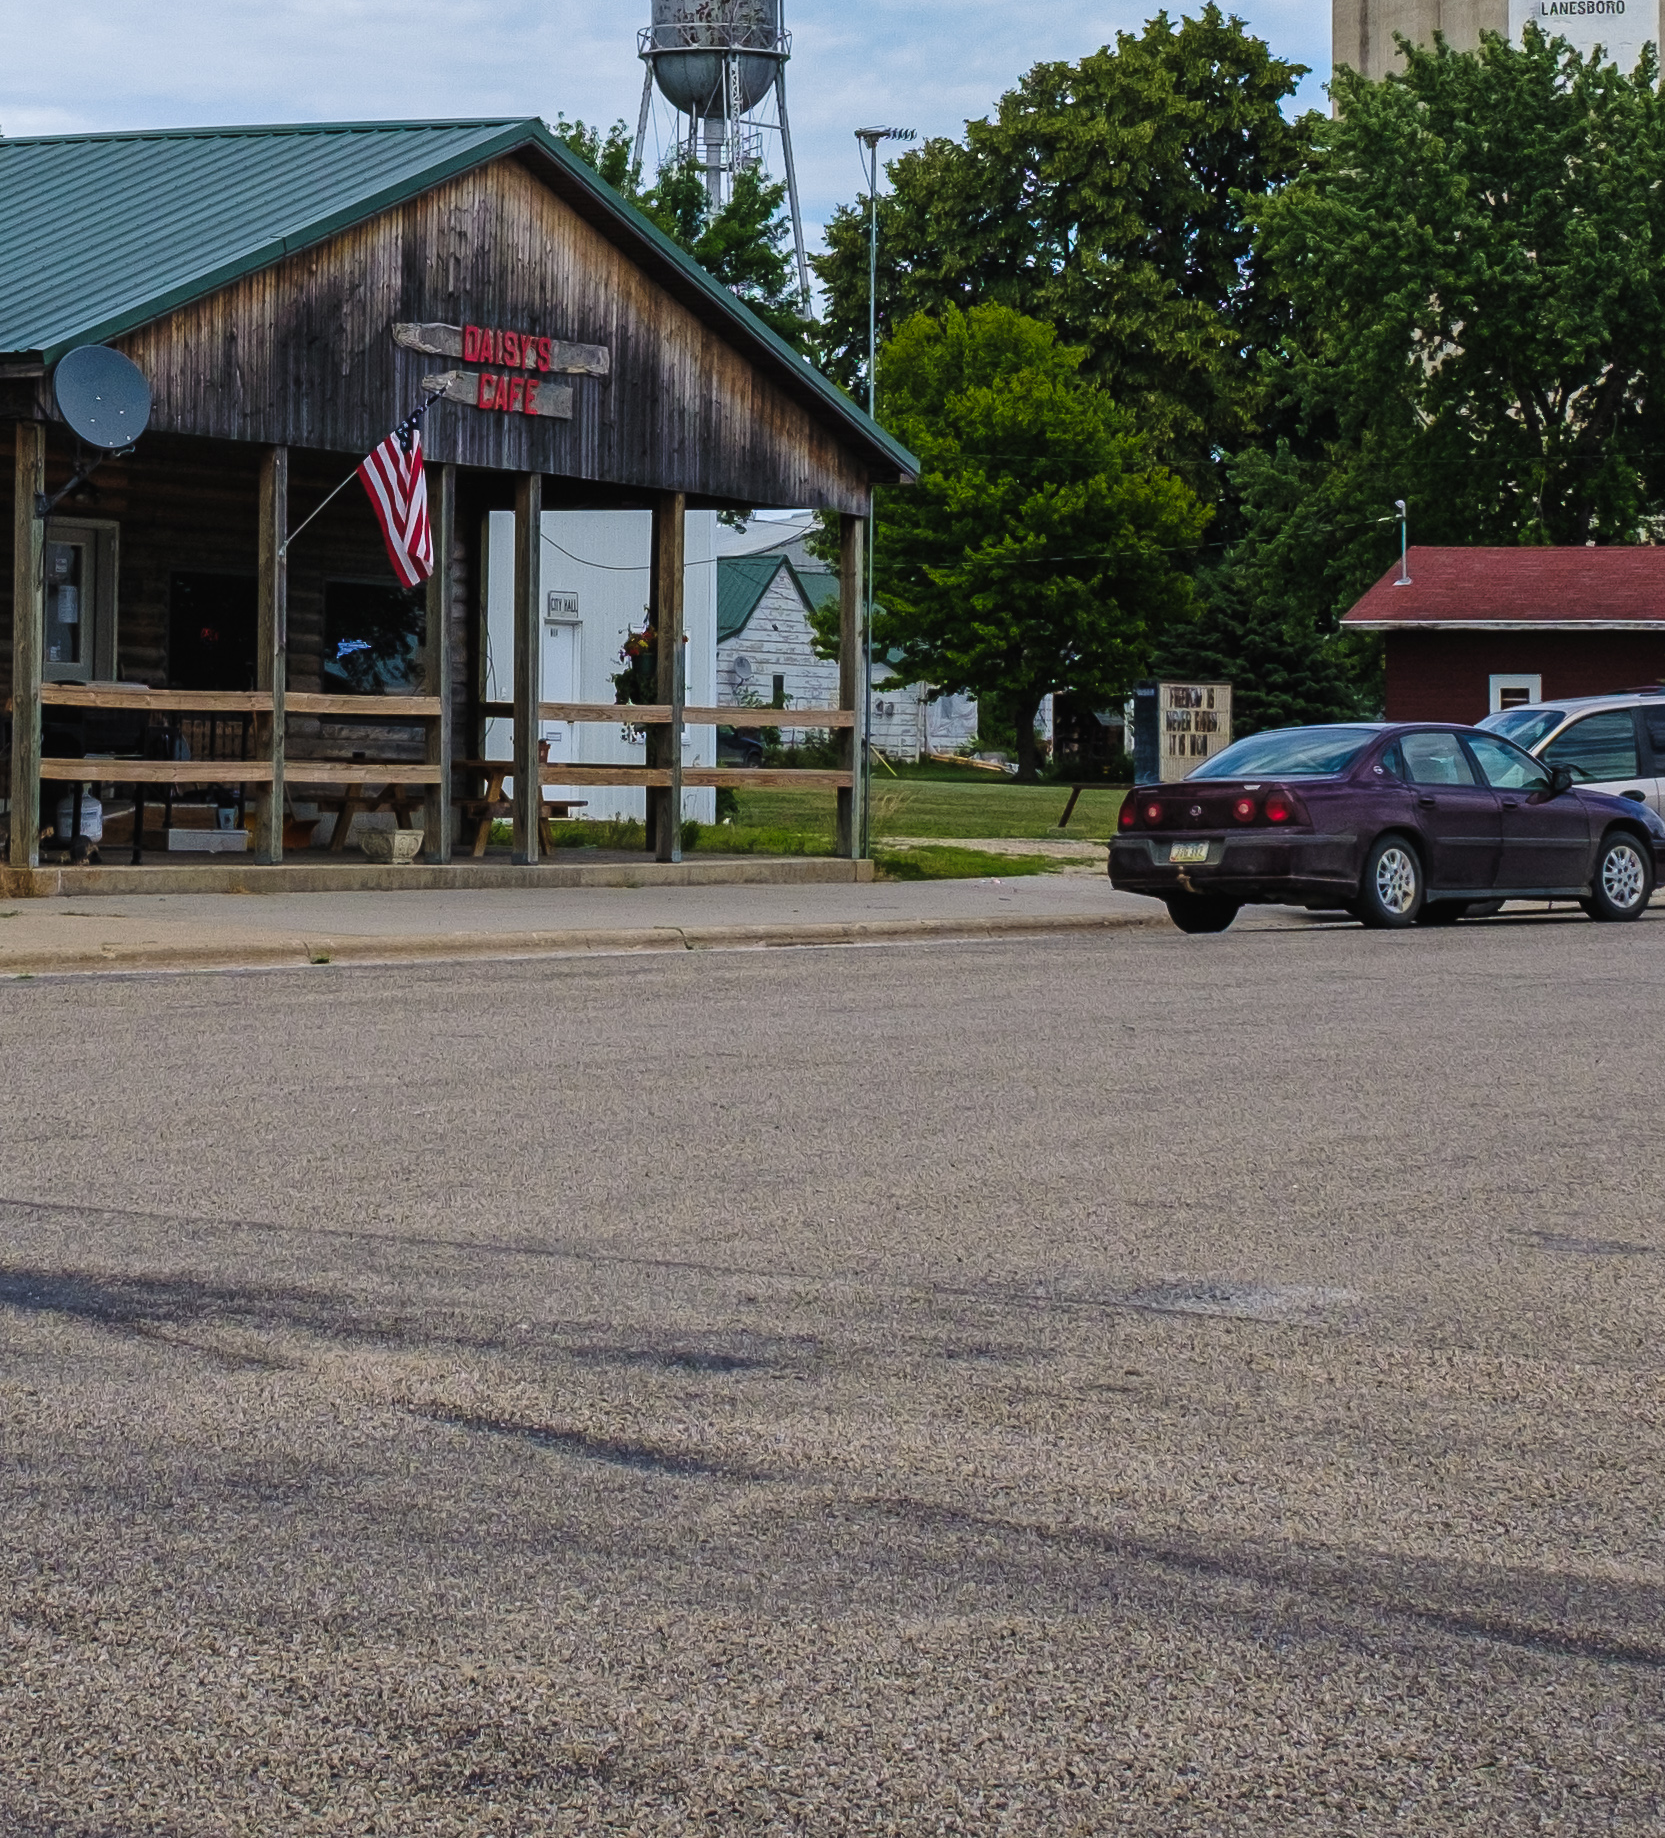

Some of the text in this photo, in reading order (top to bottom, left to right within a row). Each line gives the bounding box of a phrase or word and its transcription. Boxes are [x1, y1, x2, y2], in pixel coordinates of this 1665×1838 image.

[1541, 0, 1625, 16] LANESBORO
[463, 325, 551, 372] DAISY'S
[478, 373, 540, 416] CAFE
[550, 597, 578, 613] CITY HALL
